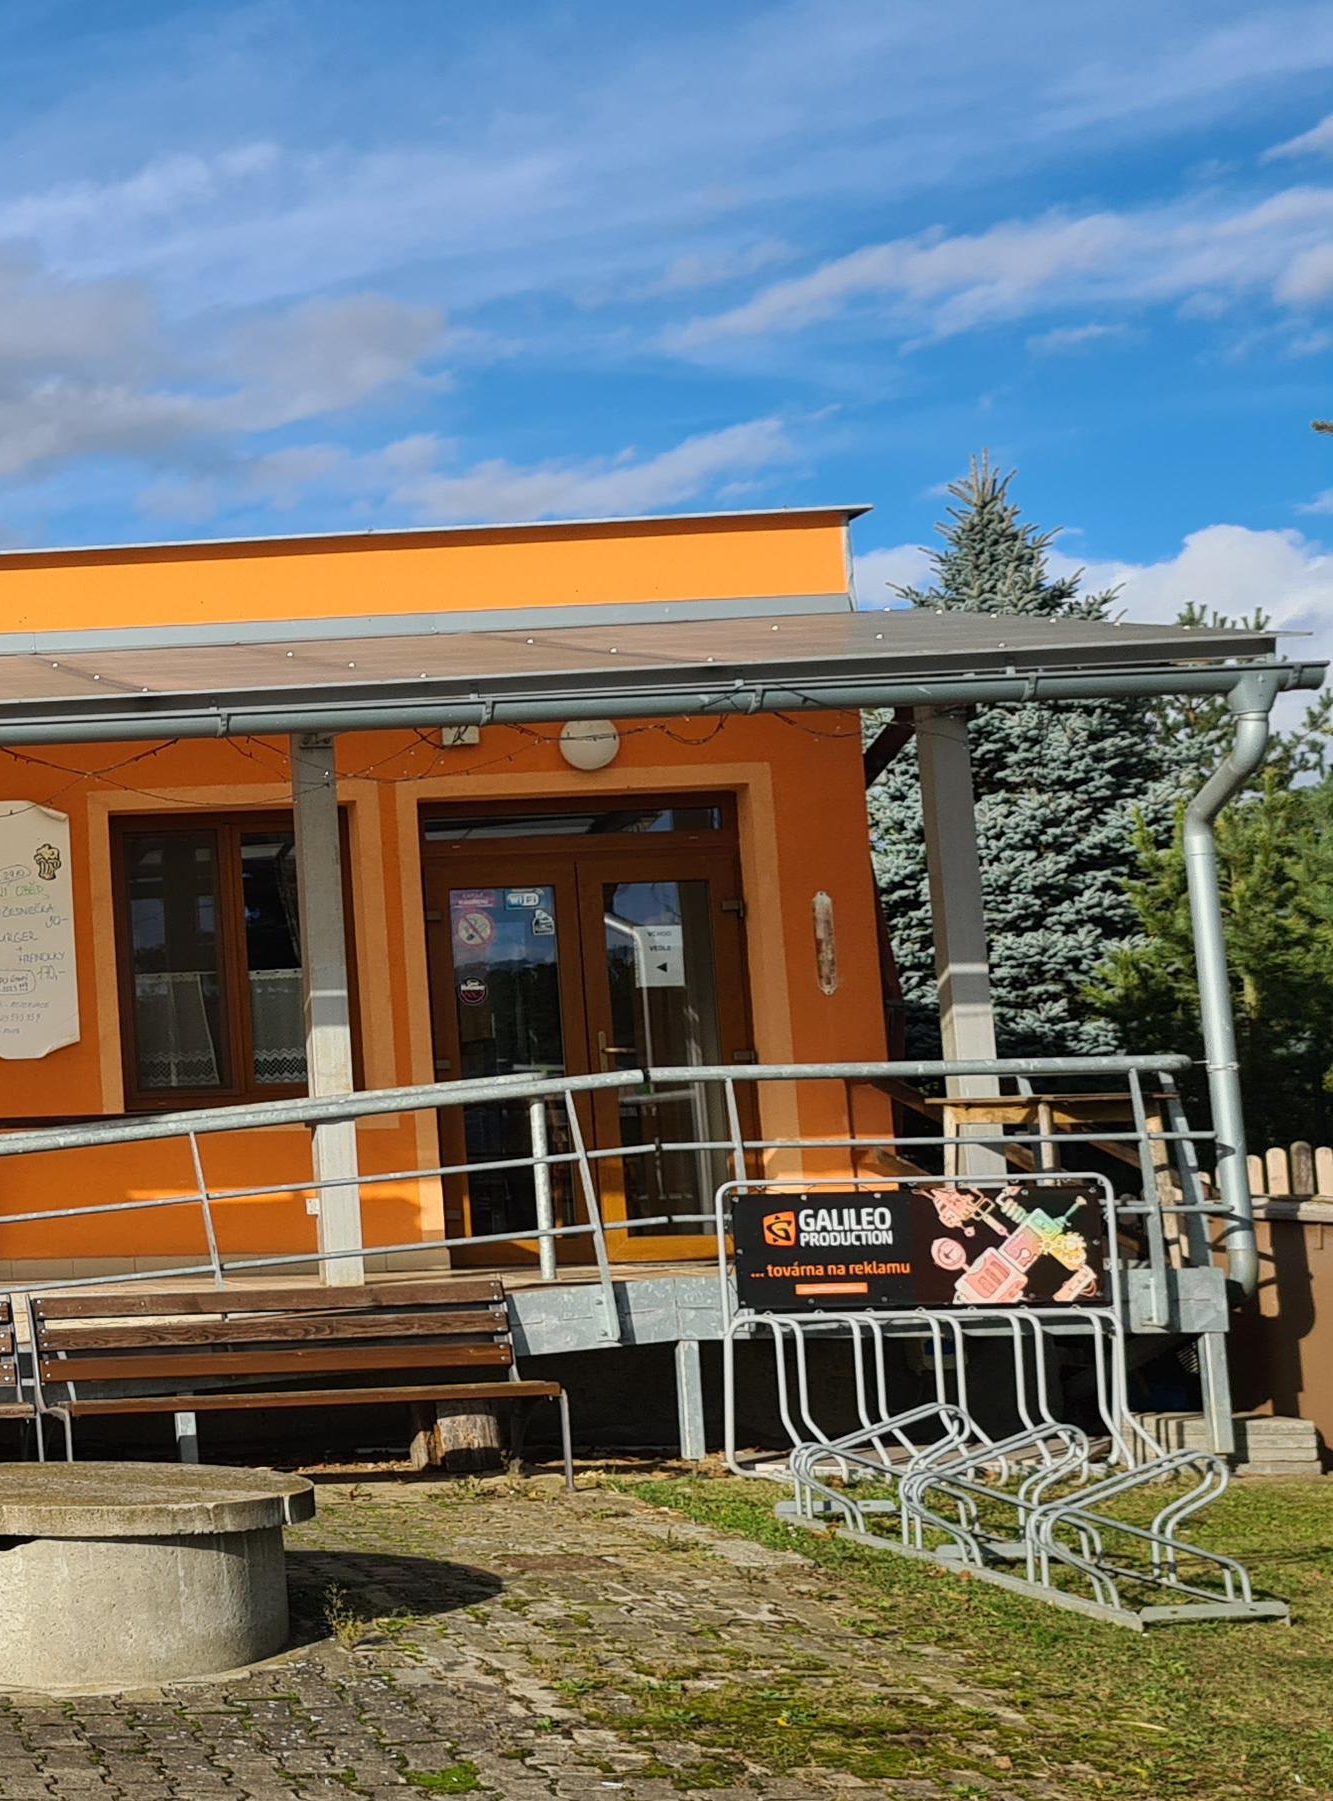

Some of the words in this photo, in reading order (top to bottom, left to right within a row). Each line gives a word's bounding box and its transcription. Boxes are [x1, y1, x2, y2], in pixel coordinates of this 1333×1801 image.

[798, 1206, 892, 1231] GALILEO
[799, 1229, 894, 1247] PRODUCTION
[766, 1262, 825, 1278] továrna
[827, 1264, 847, 1277] na
[848, 1260, 911, 1276] reklamu
